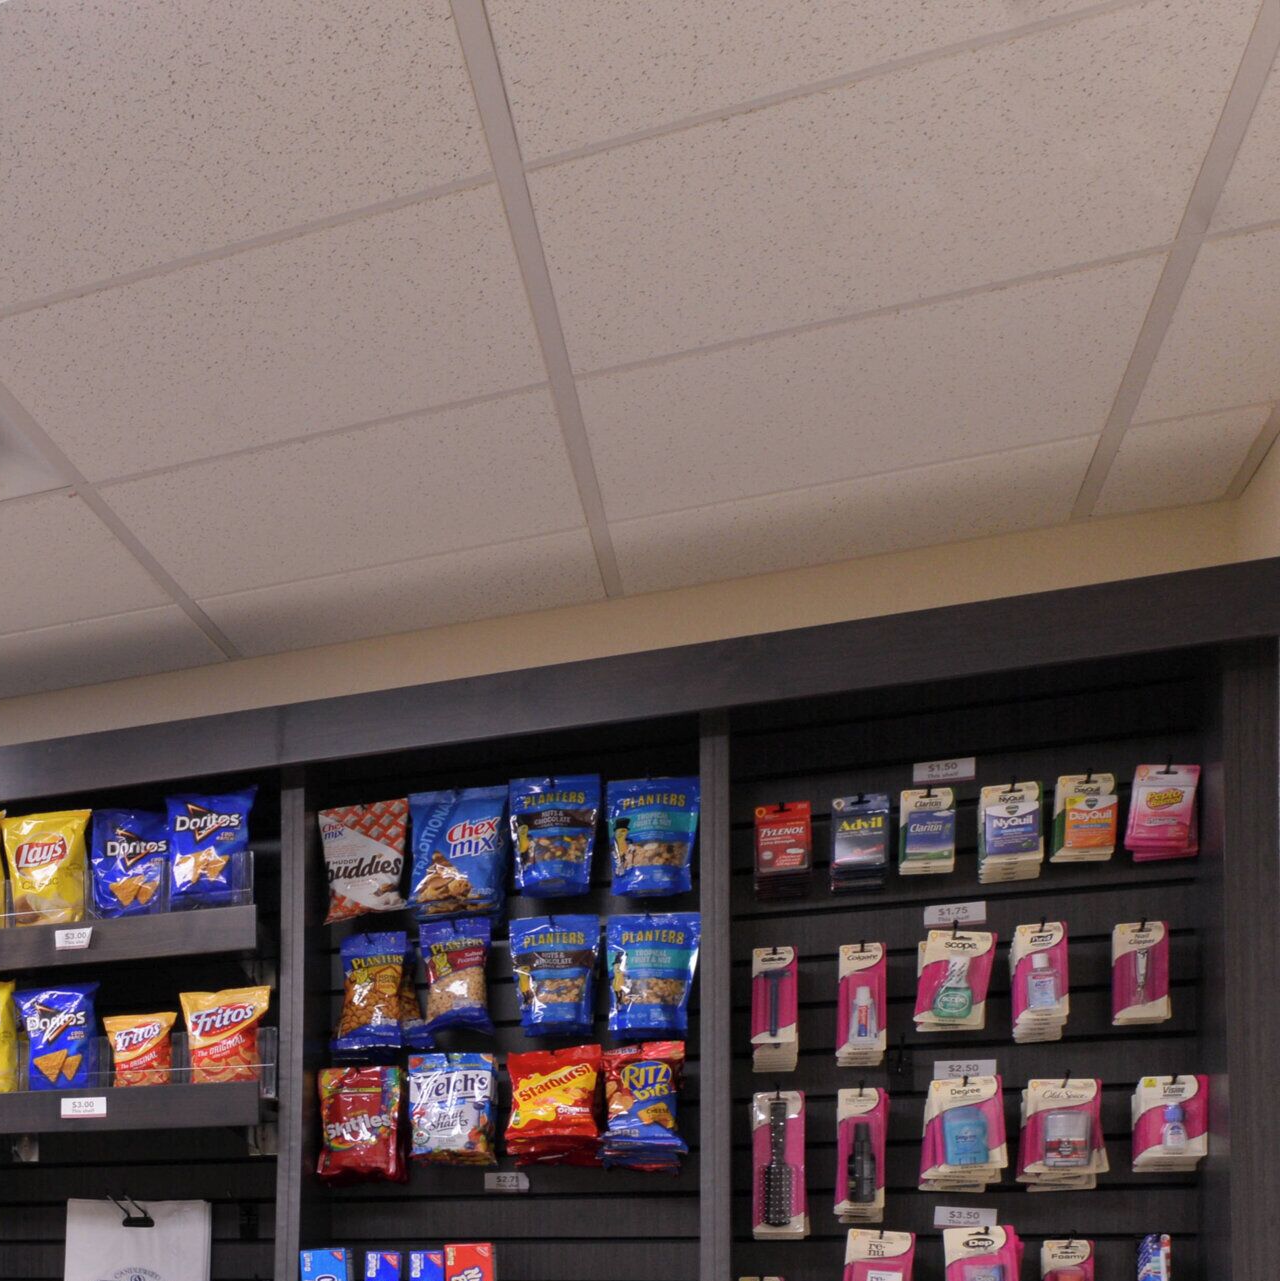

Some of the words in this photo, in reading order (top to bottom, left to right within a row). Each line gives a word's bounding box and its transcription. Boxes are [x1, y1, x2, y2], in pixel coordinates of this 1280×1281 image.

[928, 762, 958, 773] $1.50
[524, 792, 585, 809] PLANTERS
[623, 794, 686, 810] PLANTERS
[914, 800, 942, 810] Claritin
[998, 794, 1025, 804] NyQuil
[175, 812, 239, 832] Doritos
[992, 815, 1033, 829] NyQuil
[1069, 810, 1113, 823] DayQuil
[447, 816, 500, 844] Chex
[840, 816, 883, 832] Advil
[910, 823, 942, 834] Claritin
[413, 793, 455, 877] TRADITIONAL
[759, 826, 805, 838] TYLENOL
[107, 838, 167, 857] Doritos
[450, 836, 494, 859] mix
[326, 855, 401, 884] buddies
[938, 905, 969, 916] $1.75
[64, 931, 87, 940] $3.00
[523, 933, 585, 947] PLANTERS
[621, 931, 684, 945] PLANTERS
[351, 954, 404, 969] PLANTERS
[846, 953, 879, 963] Colgate
[191, 1002, 255, 1038] Fritos
[115, 1022, 161, 1050] Fritos
[208, 1037, 246, 1056] ORIGINAL
[624, 1064, 670, 1086] RITZ
[948, 1063, 979, 1073] $2.50
[518, 1063, 590, 1103] Starburst
[634, 1084, 669, 1101] bits
[950, 1087, 981, 1098] Degree
[71, 1100, 94, 1109] $3.00
[326, 1112, 391, 1140] Skittles
[948, 1210, 980, 1221] $3.50
[1051, 1253, 1085, 1263] Foamy
